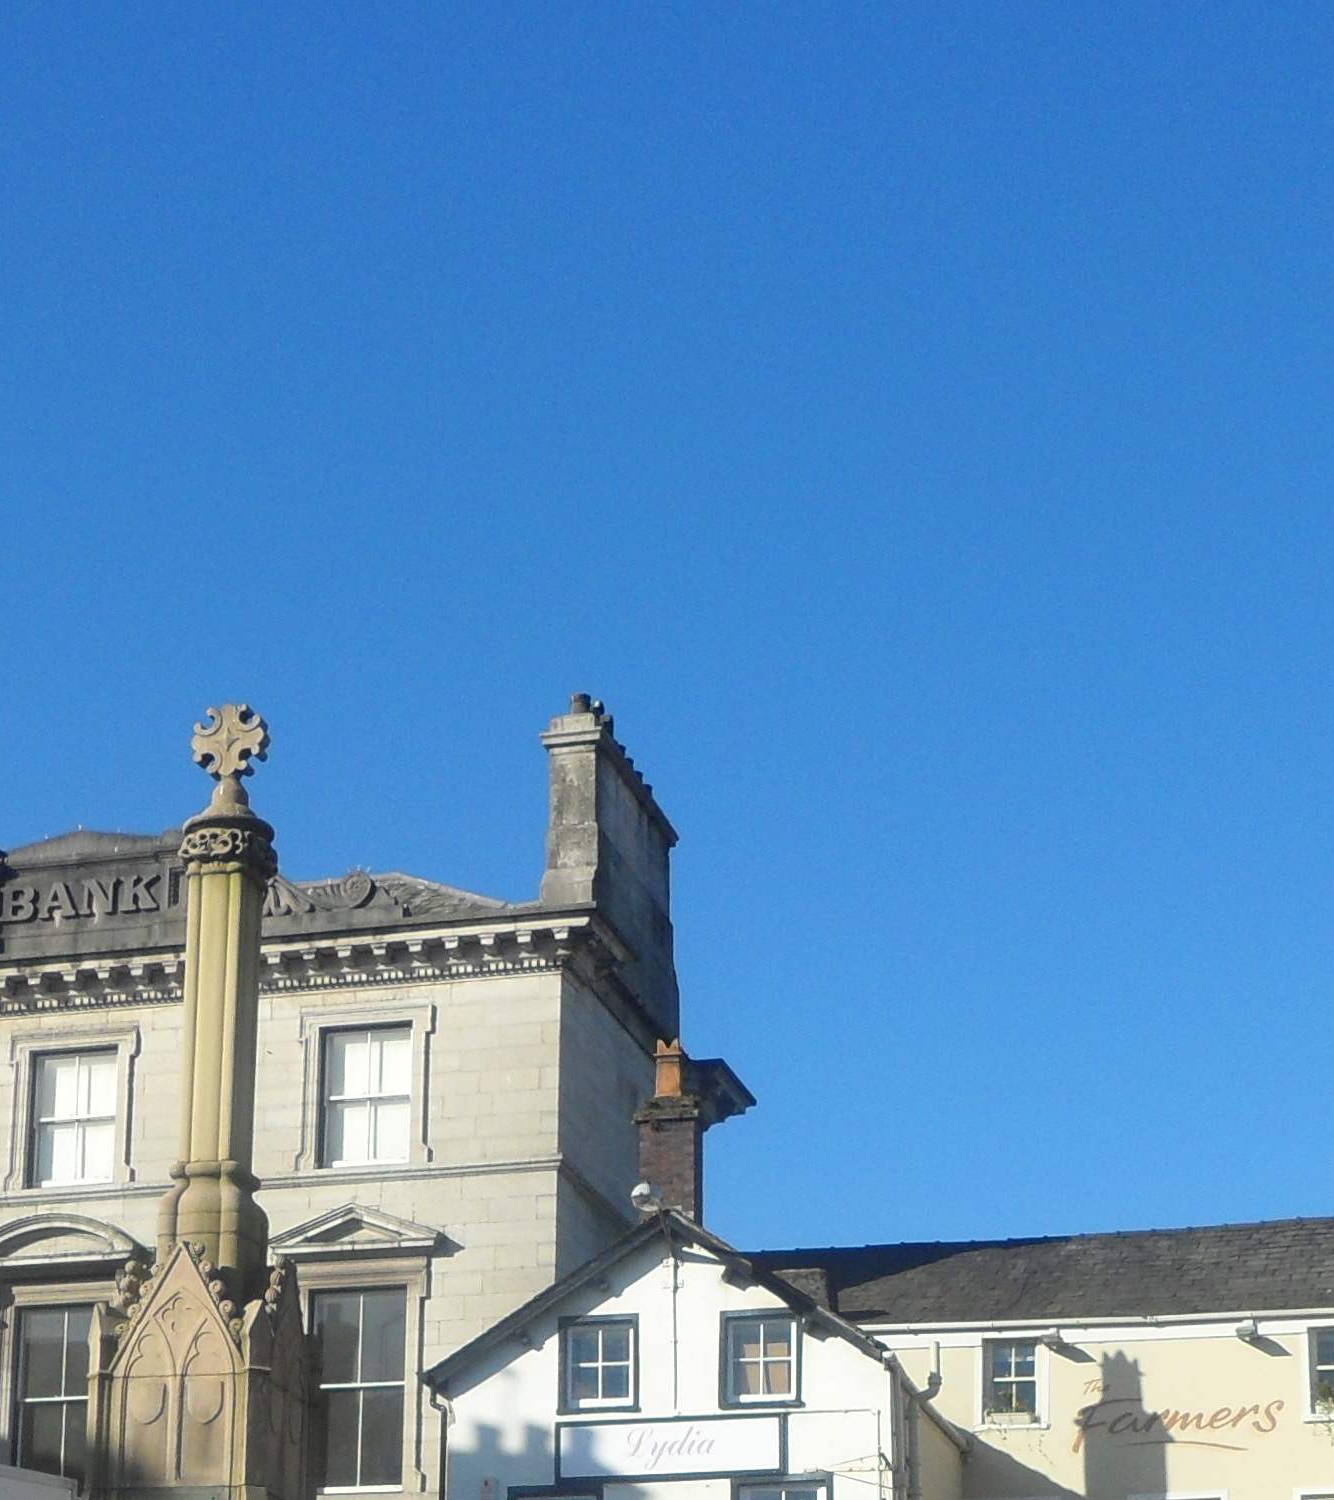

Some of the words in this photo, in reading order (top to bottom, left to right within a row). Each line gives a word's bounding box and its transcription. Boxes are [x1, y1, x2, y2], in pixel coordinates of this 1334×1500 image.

[1083, 1378, 1110, 1396] The
[626, 1426, 716, 1470] Lydia
[1071, 1398, 1285, 1454] Farmers
